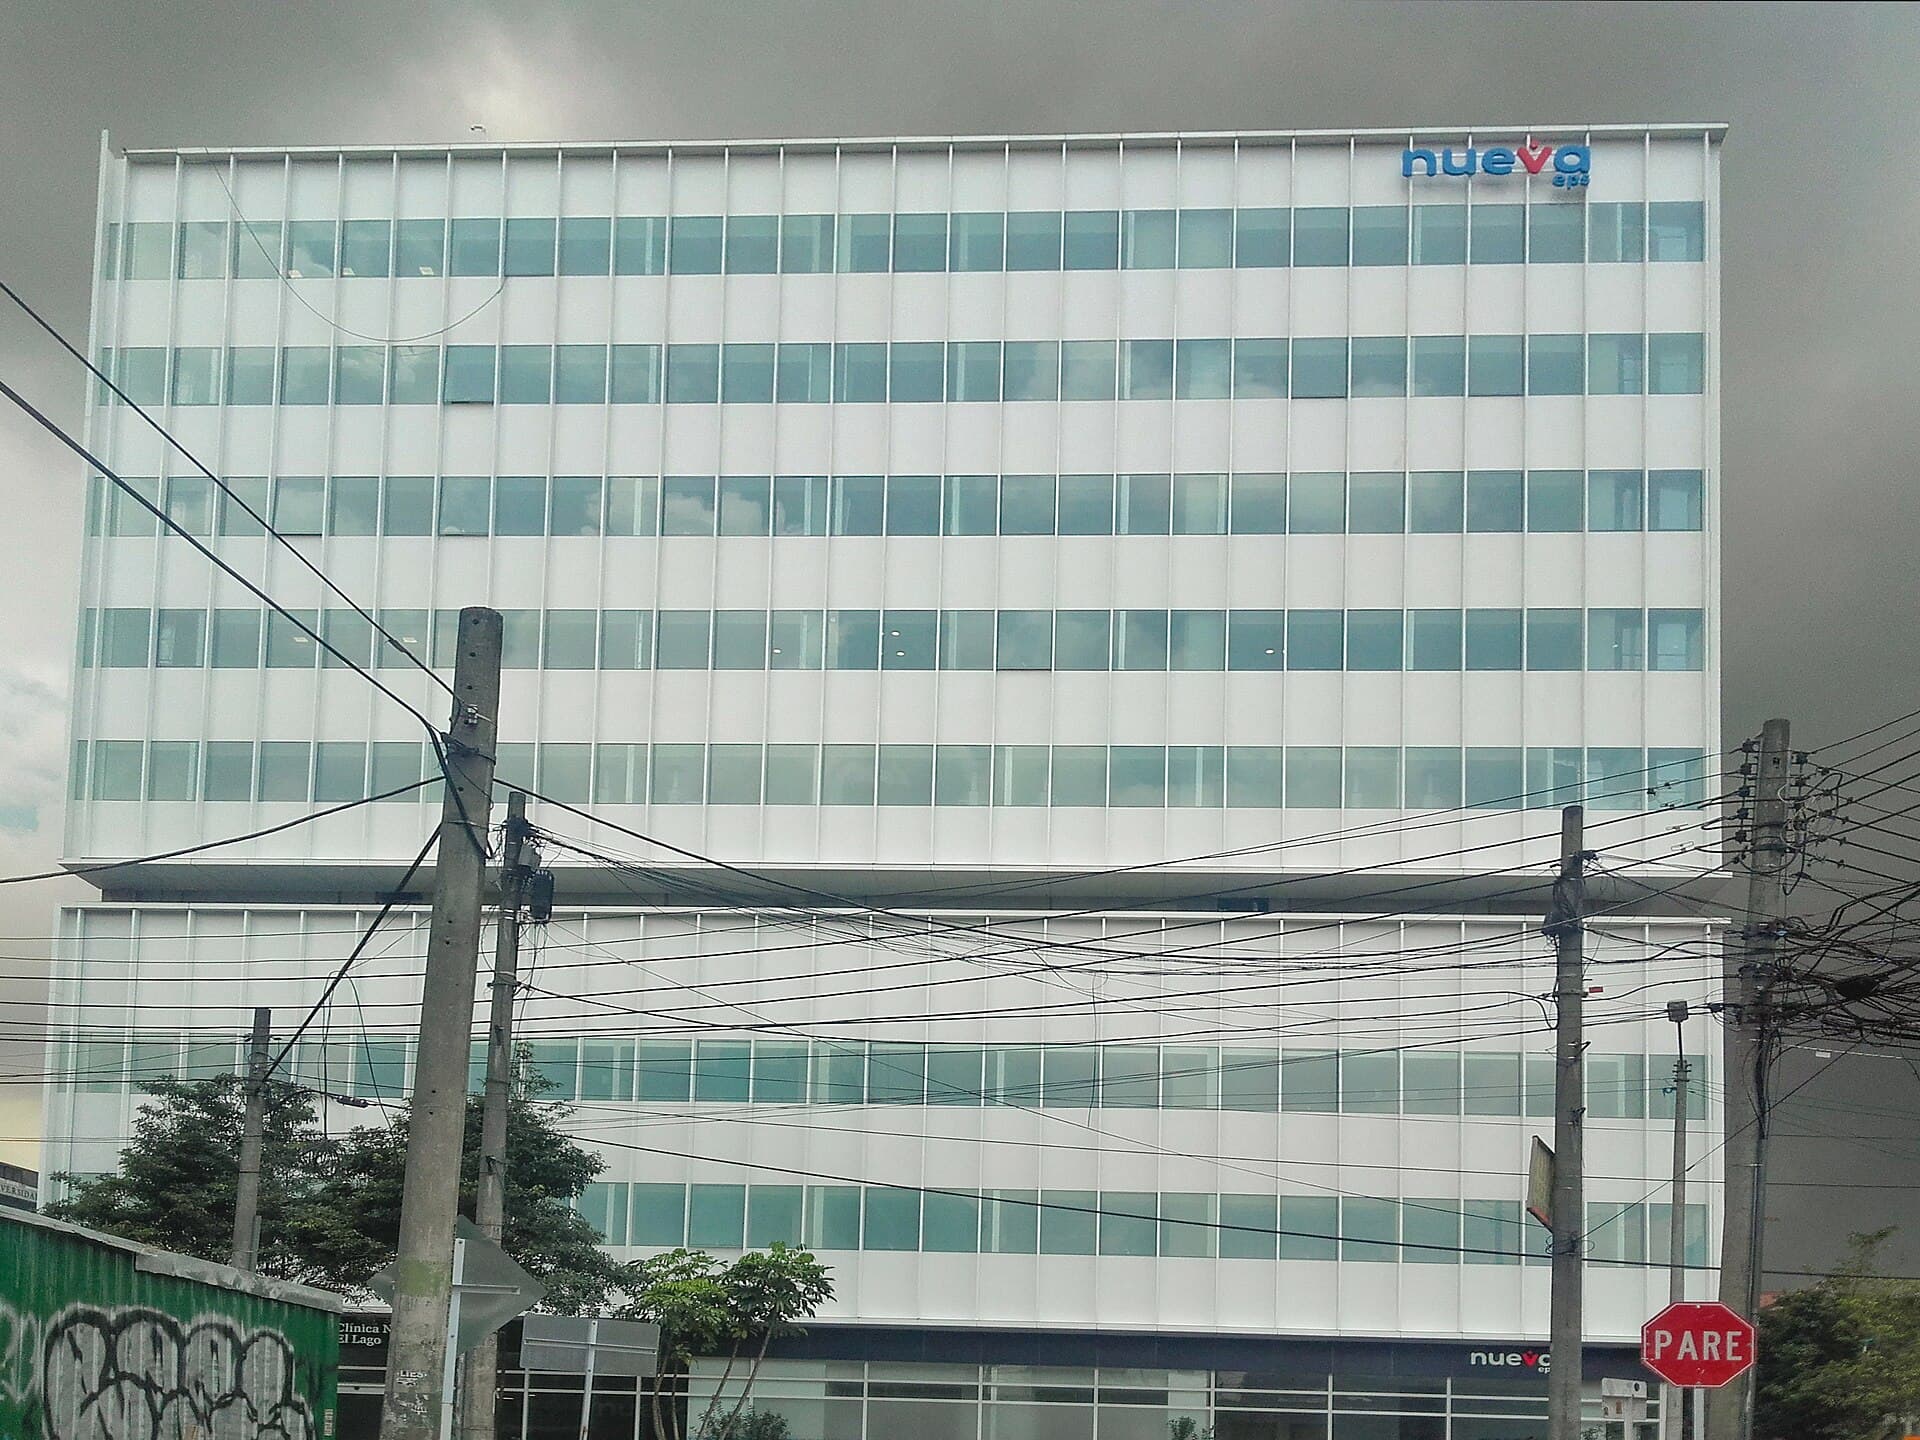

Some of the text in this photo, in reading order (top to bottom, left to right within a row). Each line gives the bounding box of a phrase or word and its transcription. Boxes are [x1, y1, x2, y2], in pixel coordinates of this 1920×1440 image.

[1402, 142, 1591, 177] nueva
[1552, 174, 1591, 190] eps
[352, 1334, 382, 1347] Lago
[1655, 1330, 1742, 1361] PARE
